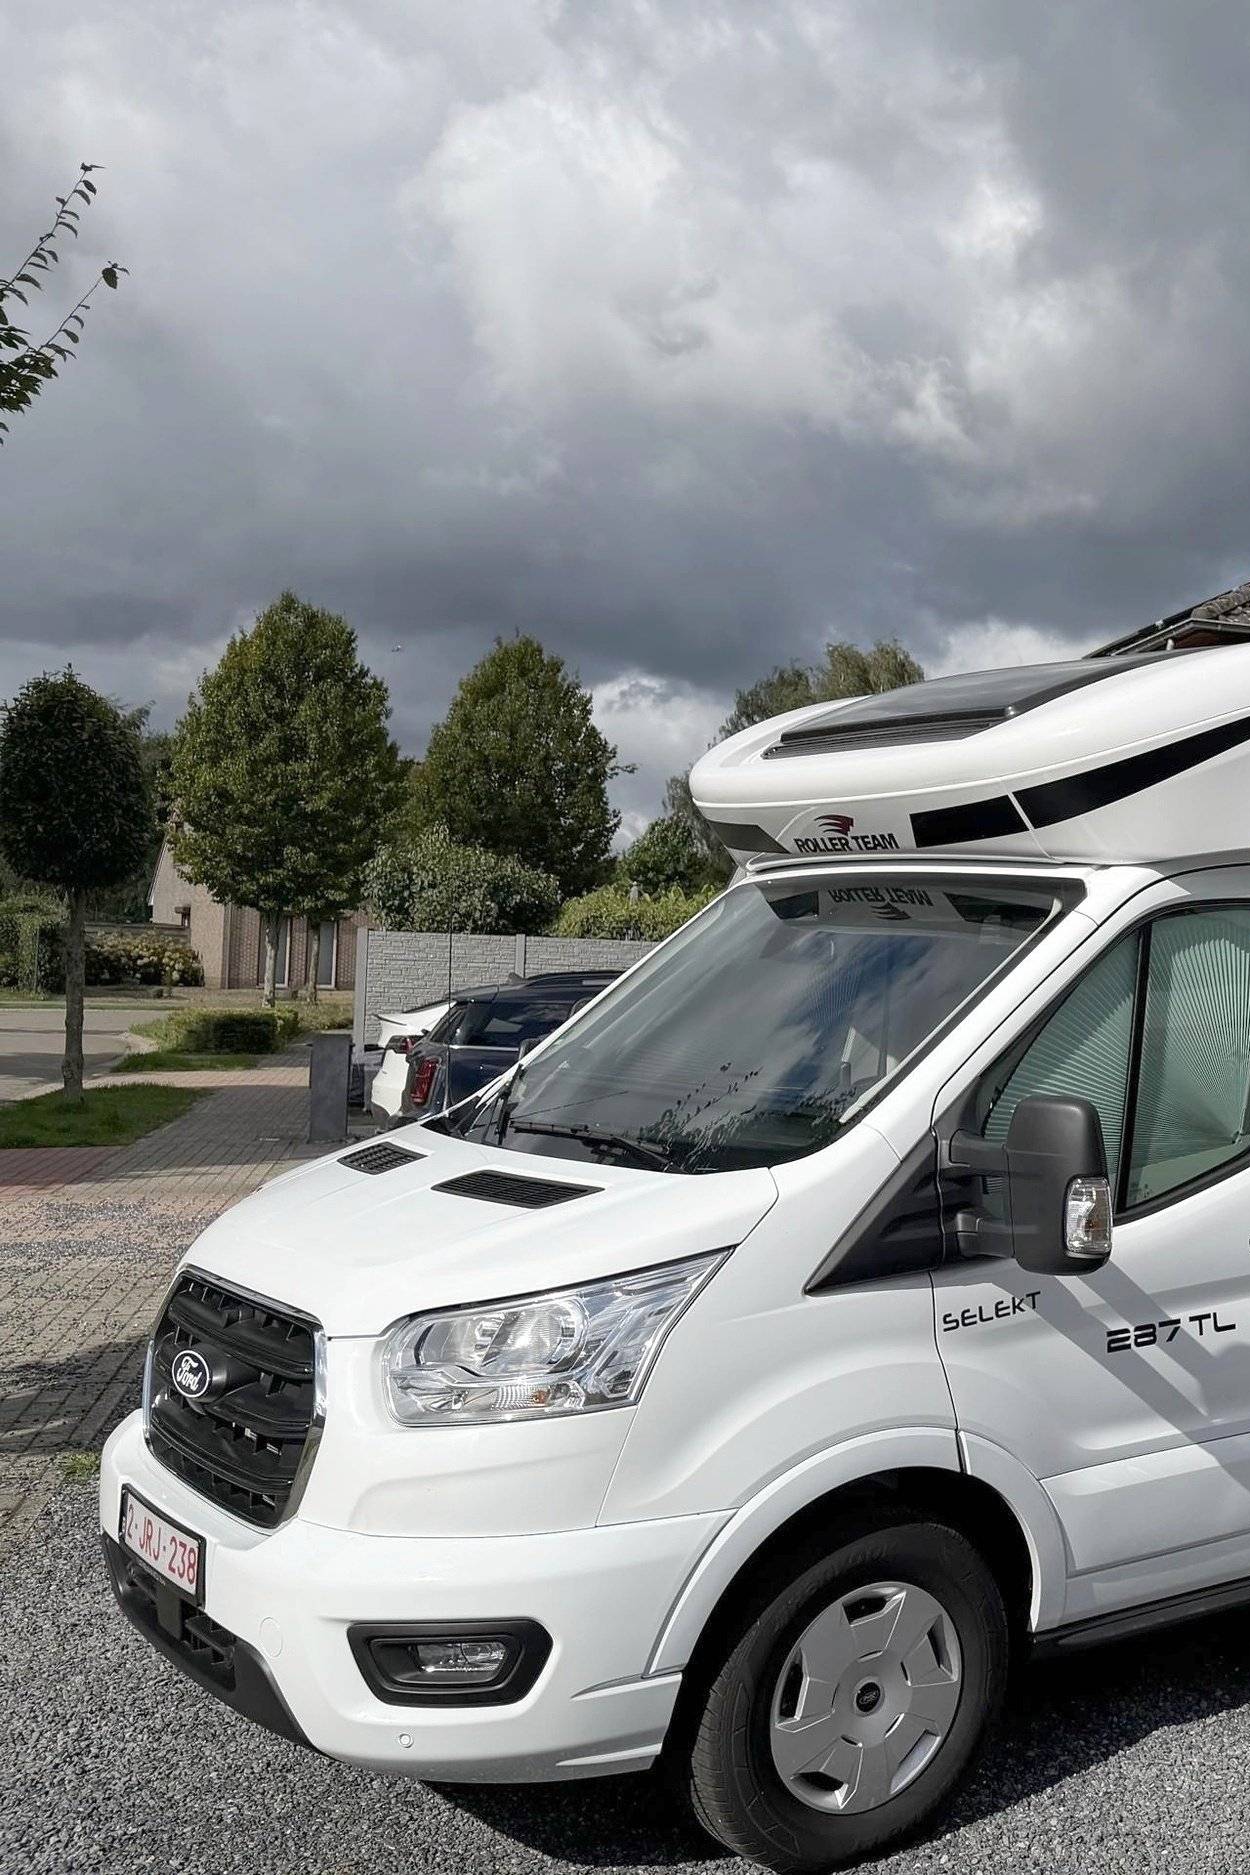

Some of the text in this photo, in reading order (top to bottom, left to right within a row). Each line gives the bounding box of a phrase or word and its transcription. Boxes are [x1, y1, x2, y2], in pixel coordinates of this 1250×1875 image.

[793, 832, 901, 854] ROLLER TEAM
[942, 1290, 1042, 1333] SELEKT
[1105, 1312, 1237, 1354] 287 TL
[176, 1355, 203, 1392] Ford
